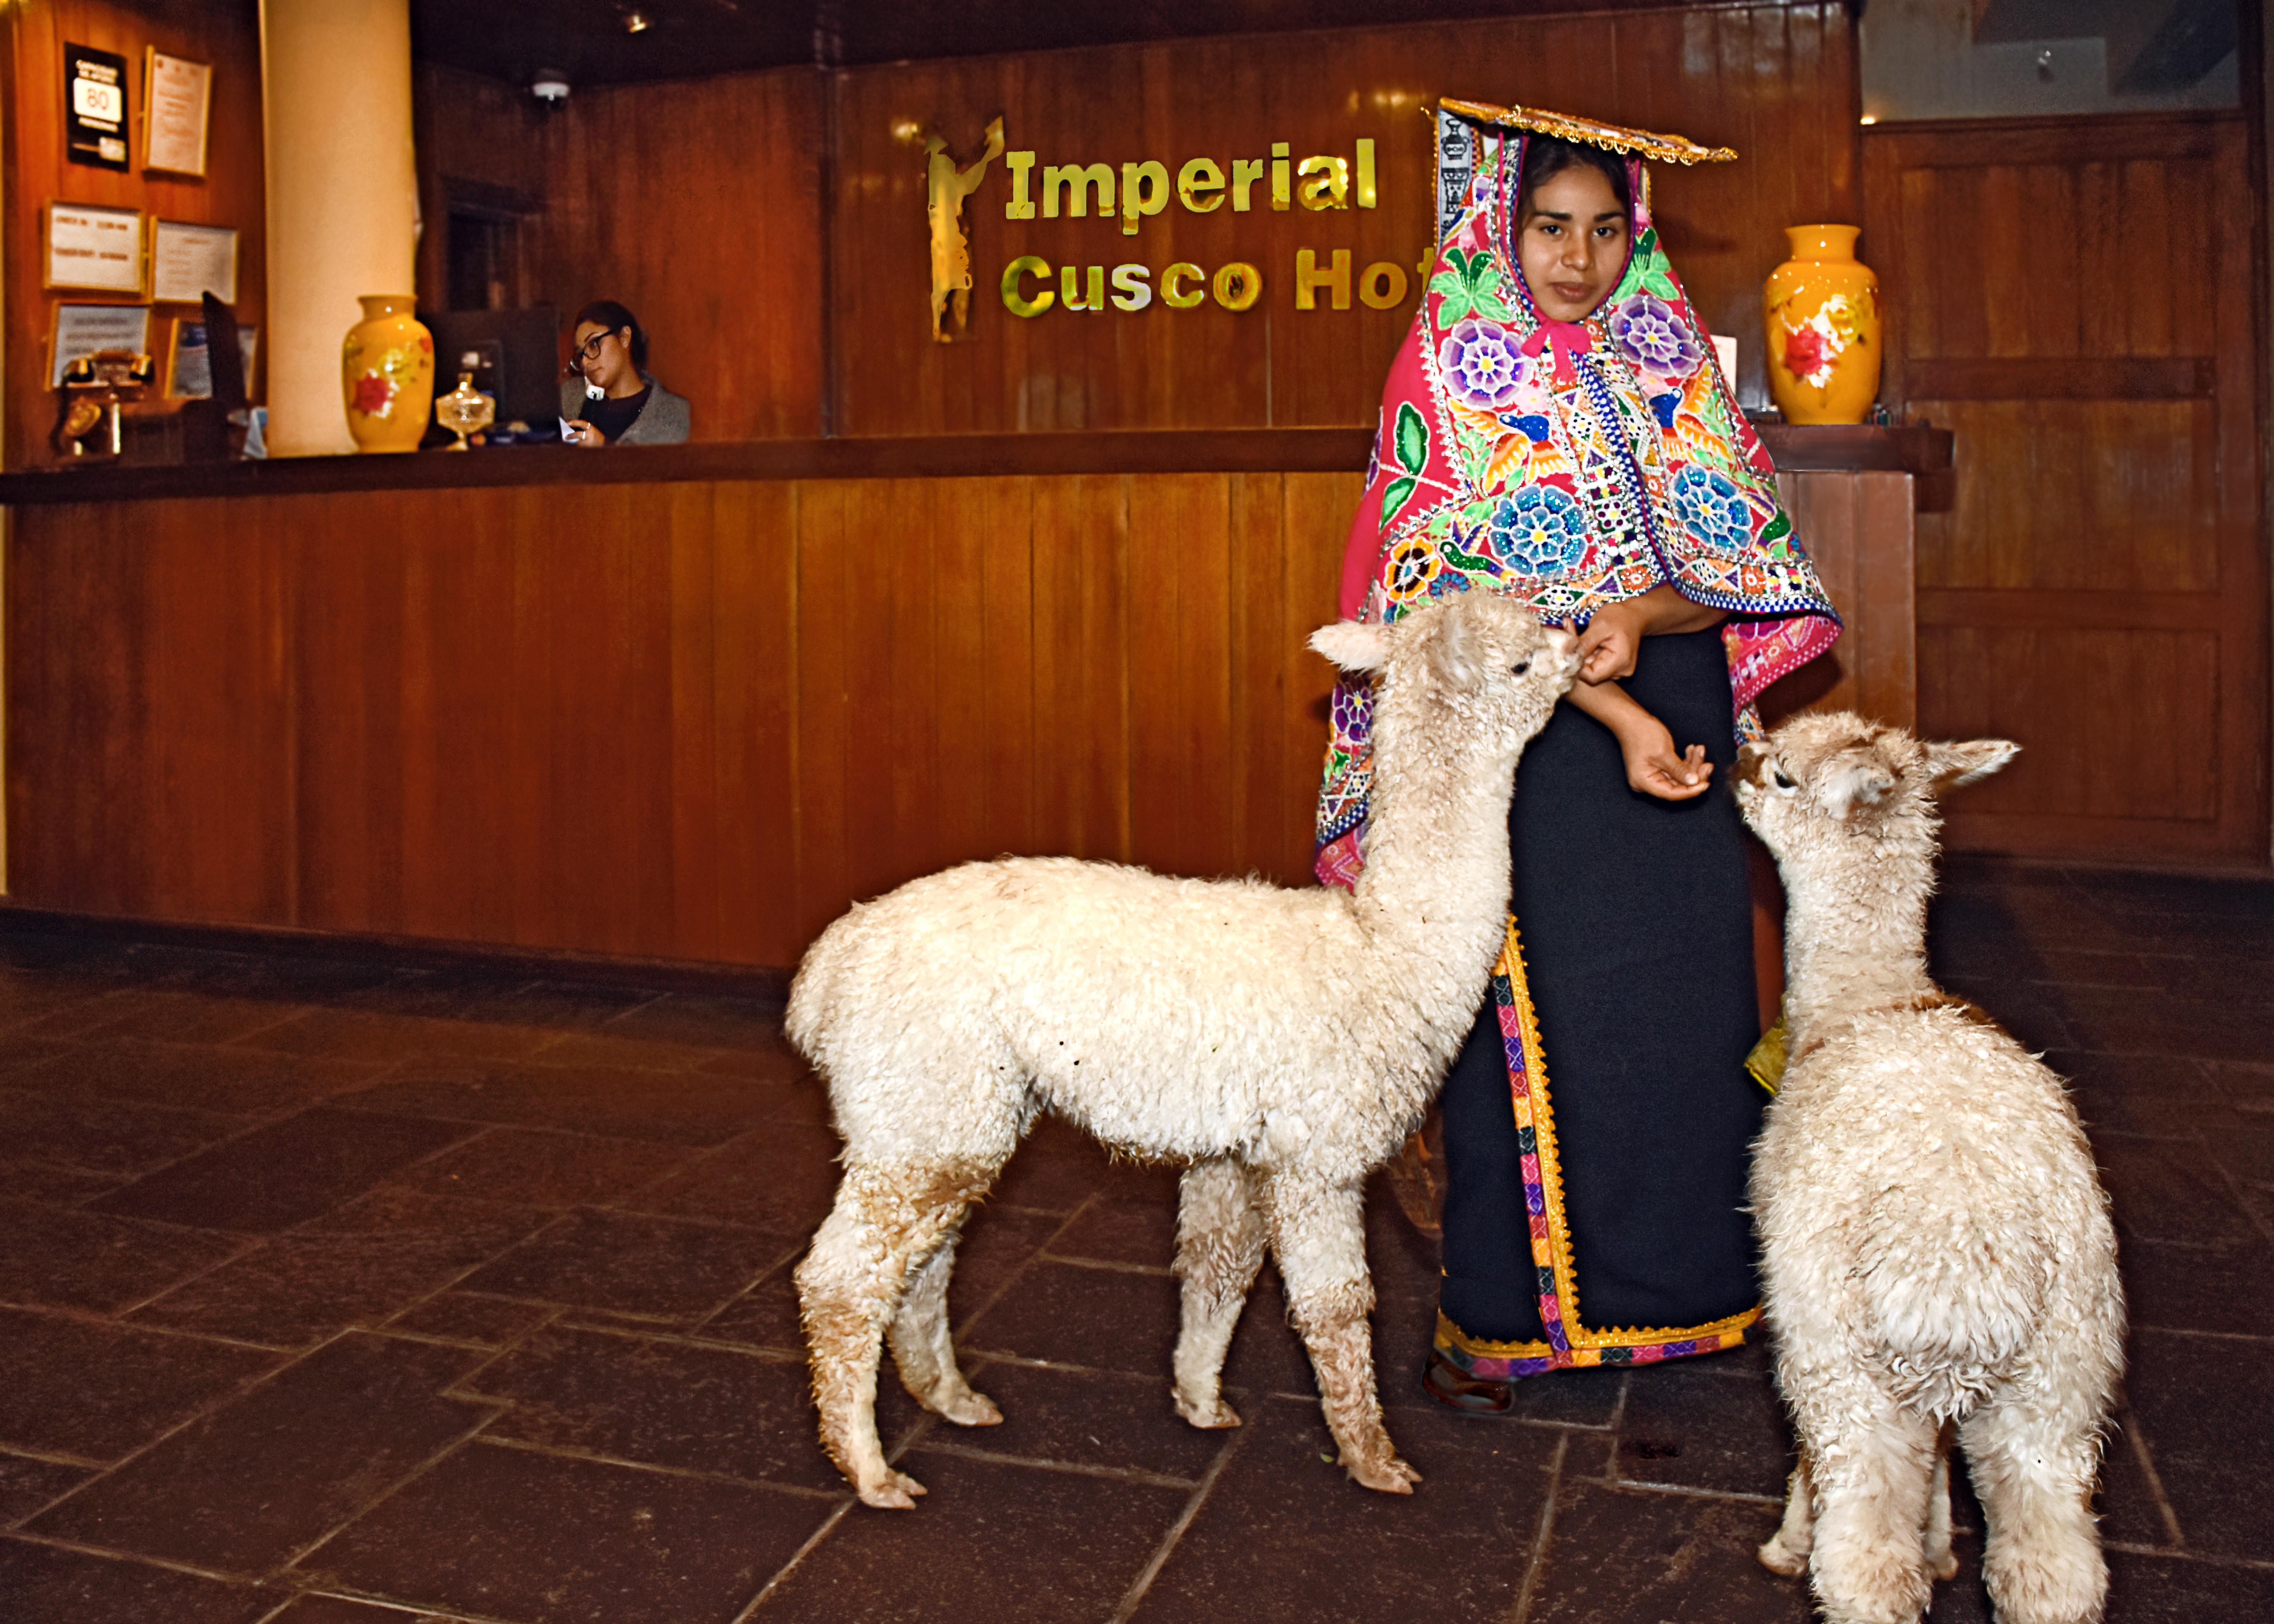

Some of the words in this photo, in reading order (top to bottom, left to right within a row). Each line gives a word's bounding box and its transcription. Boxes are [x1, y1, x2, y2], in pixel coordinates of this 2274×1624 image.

[87, 88, 109, 110] 80
[1006, 138, 1376, 235] Imperial
[1001, 256, 1262, 317] Cusco
